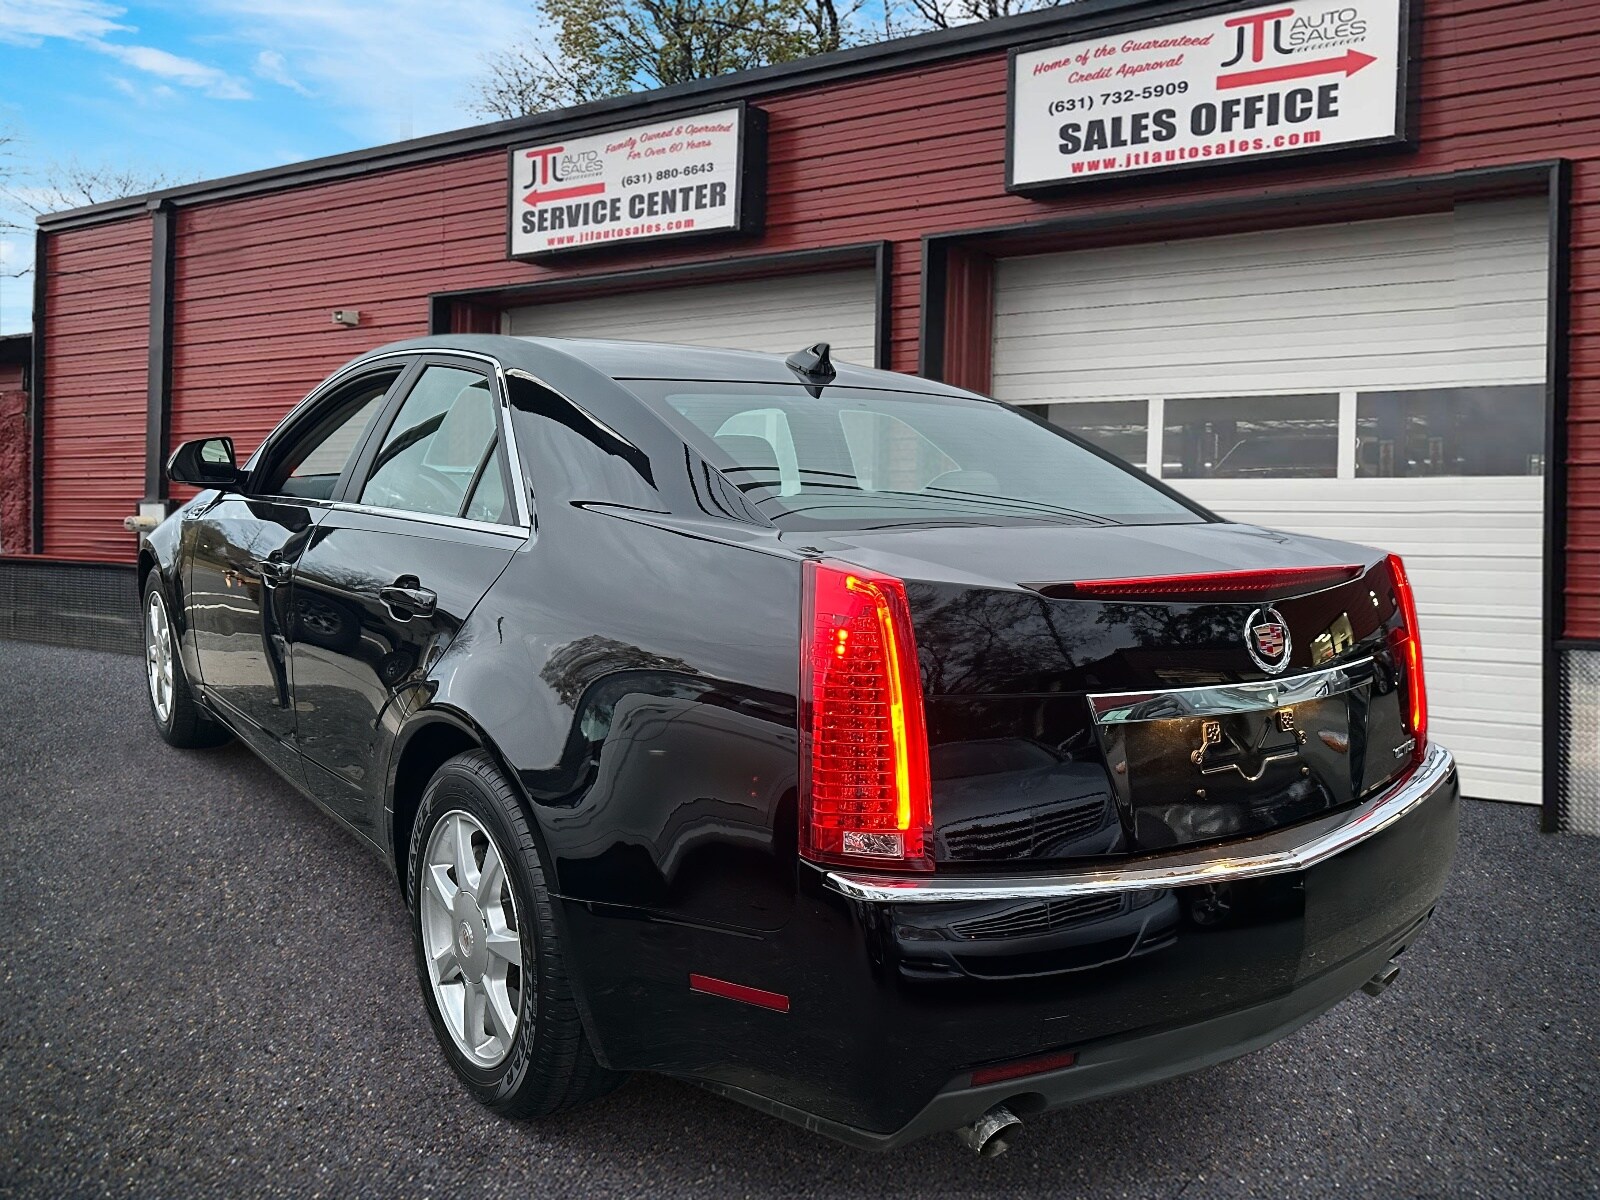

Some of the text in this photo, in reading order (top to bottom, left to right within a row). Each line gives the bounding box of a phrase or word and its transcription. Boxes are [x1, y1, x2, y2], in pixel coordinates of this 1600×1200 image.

[1289, 20, 1367, 46] SALES
[1290, 8, 1357, 31] AUTO
[1221, 8, 1294, 67] JTL
[1033, 33, 1214, 76] Home of the Guaranteed
[1068, 54, 1184, 84] Credit Approval
[1048, 80, 1189, 116] (631) 732-5909
[1059, 83, 1339, 154] SALES OFFICE
[605, 122, 733, 154] Family Owned & Operated
[627, 140, 712, 160] For Over 60 Years
[1071, 130, 1321, 173] www.jtlautosales.com
[523, 146, 564, 189] JTL
[561, 150, 598, 166] AUTO
[561, 160, 603, 176] SALES
[621, 172, 652, 188] (631)
[656, 162, 714, 181] 880-6643
[522, 181, 727, 234] SERVICE CENTER
[547, 219, 695, 246] www.jtlautosales.com
